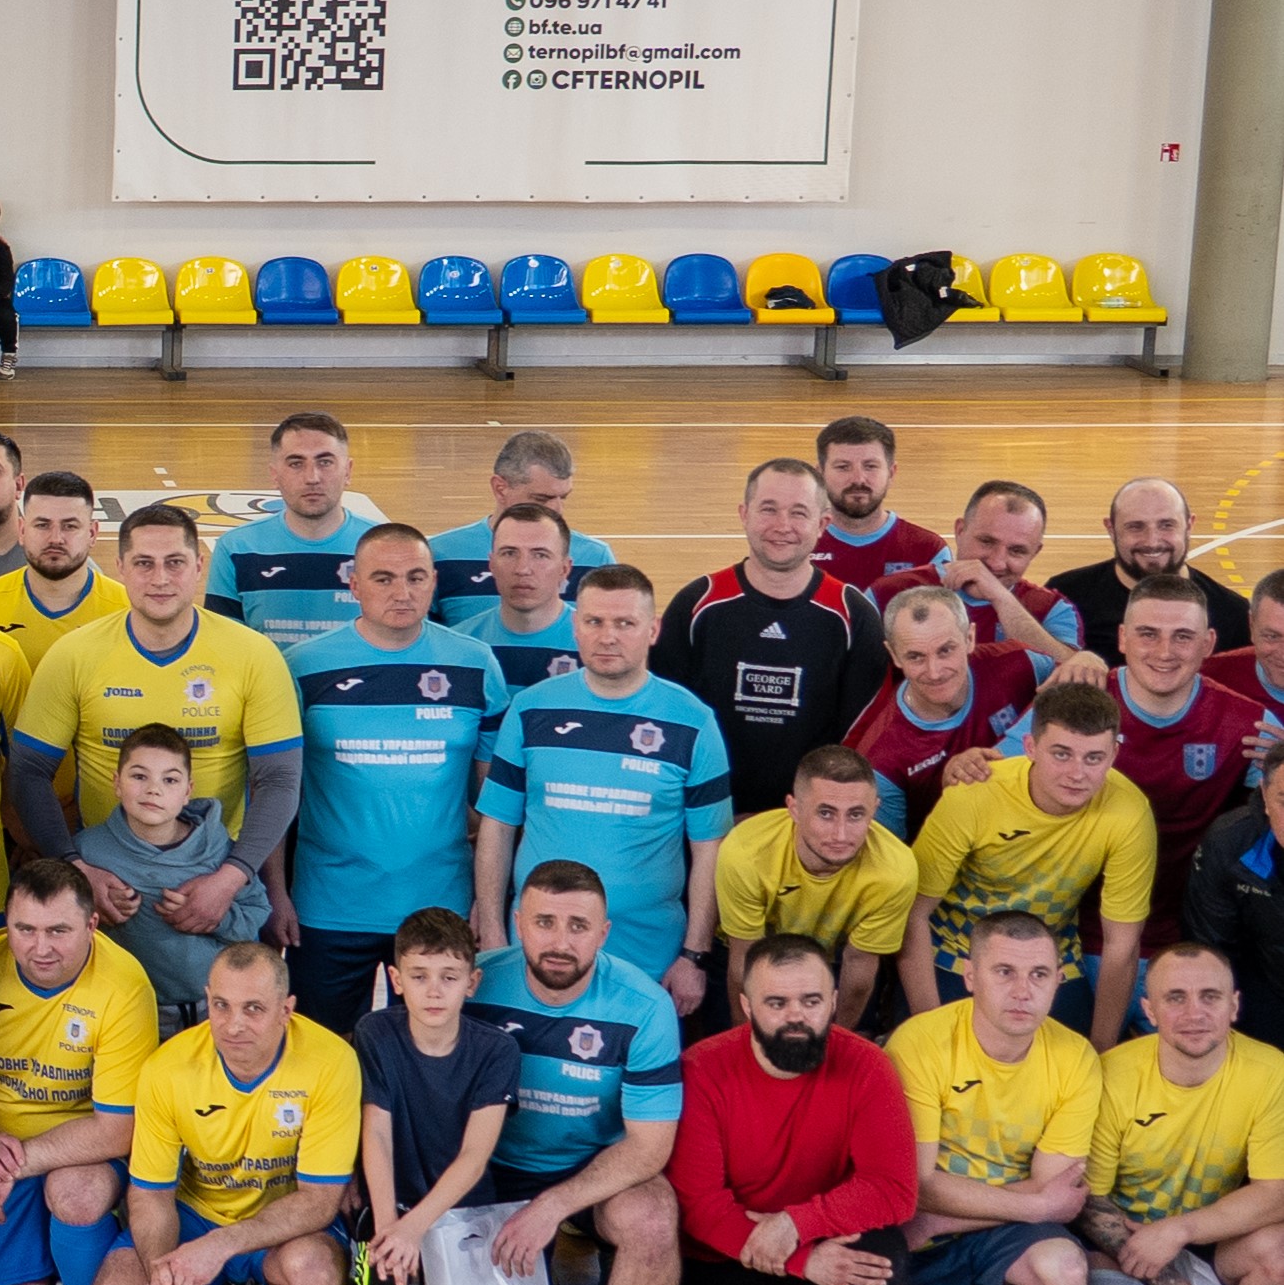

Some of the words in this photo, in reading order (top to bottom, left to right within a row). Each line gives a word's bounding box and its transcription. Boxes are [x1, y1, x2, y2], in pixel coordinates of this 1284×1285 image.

[528, 19, 603, 35] bf.te.ua
[528, 43, 741, 63] ternopilbf@gmail.com
[551, 70, 705, 90] CFTERNOPIL
[745, 674, 791, 686] GEORGE
[753, 683, 783, 694] YARD
[182, 706, 221, 717] POLICE
[416, 707, 453, 720] POLICE
[621, 757, 660, 775] POLICE
[907, 750, 947, 777] LEGEA
[562, 1063, 601, 1082] POLICE
